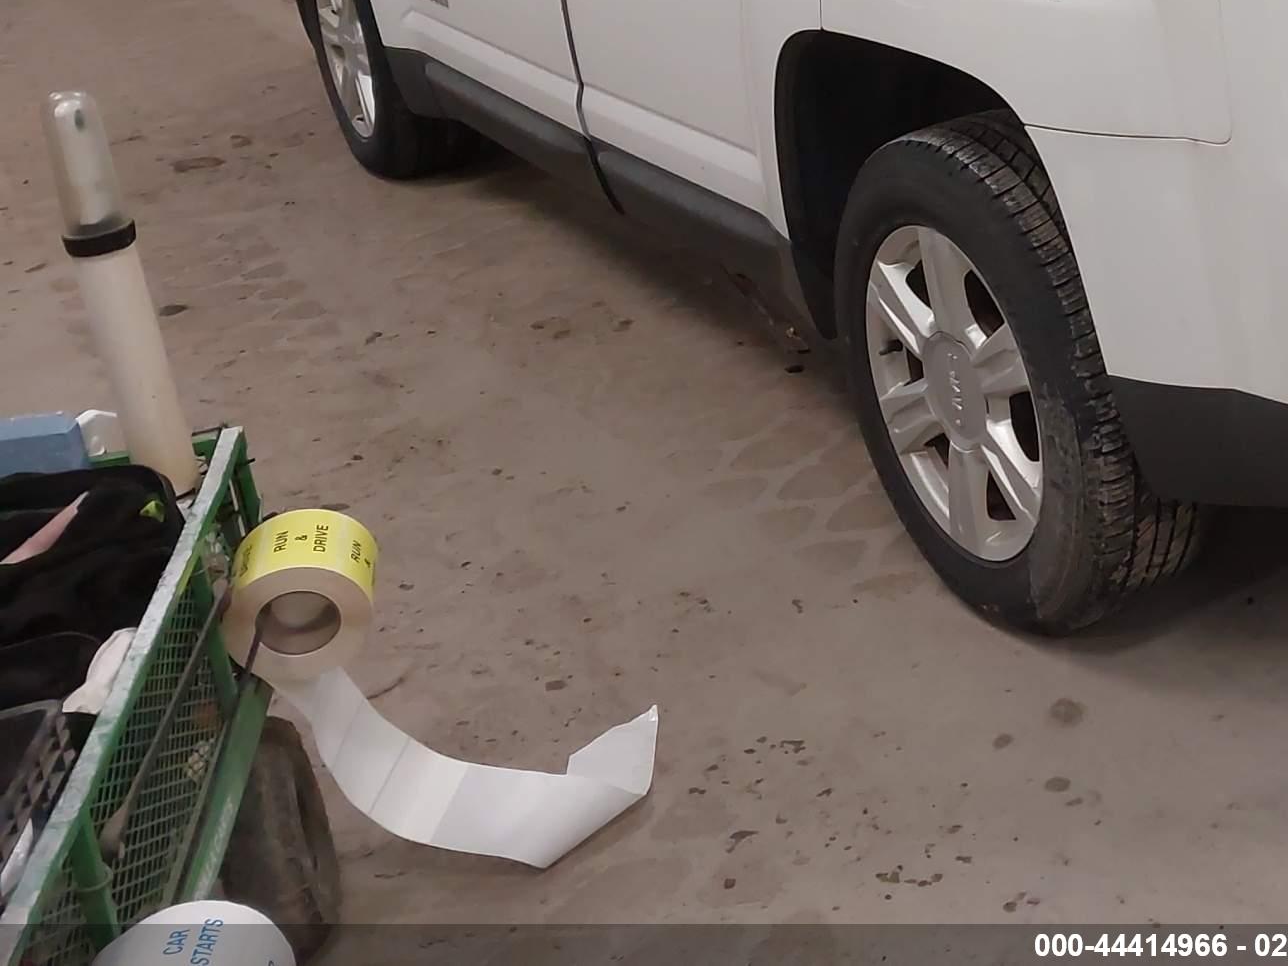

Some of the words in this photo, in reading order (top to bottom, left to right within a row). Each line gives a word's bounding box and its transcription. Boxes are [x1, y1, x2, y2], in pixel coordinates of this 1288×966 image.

[273, 530, 289, 553] RUN
[294, 534, 308, 542] &
[312, 524, 329, 553] DRIVE
[350, 540, 362, 563] RUN
[163, 928, 190, 956] CAR
[190, 918, 224, 966] STARTS
